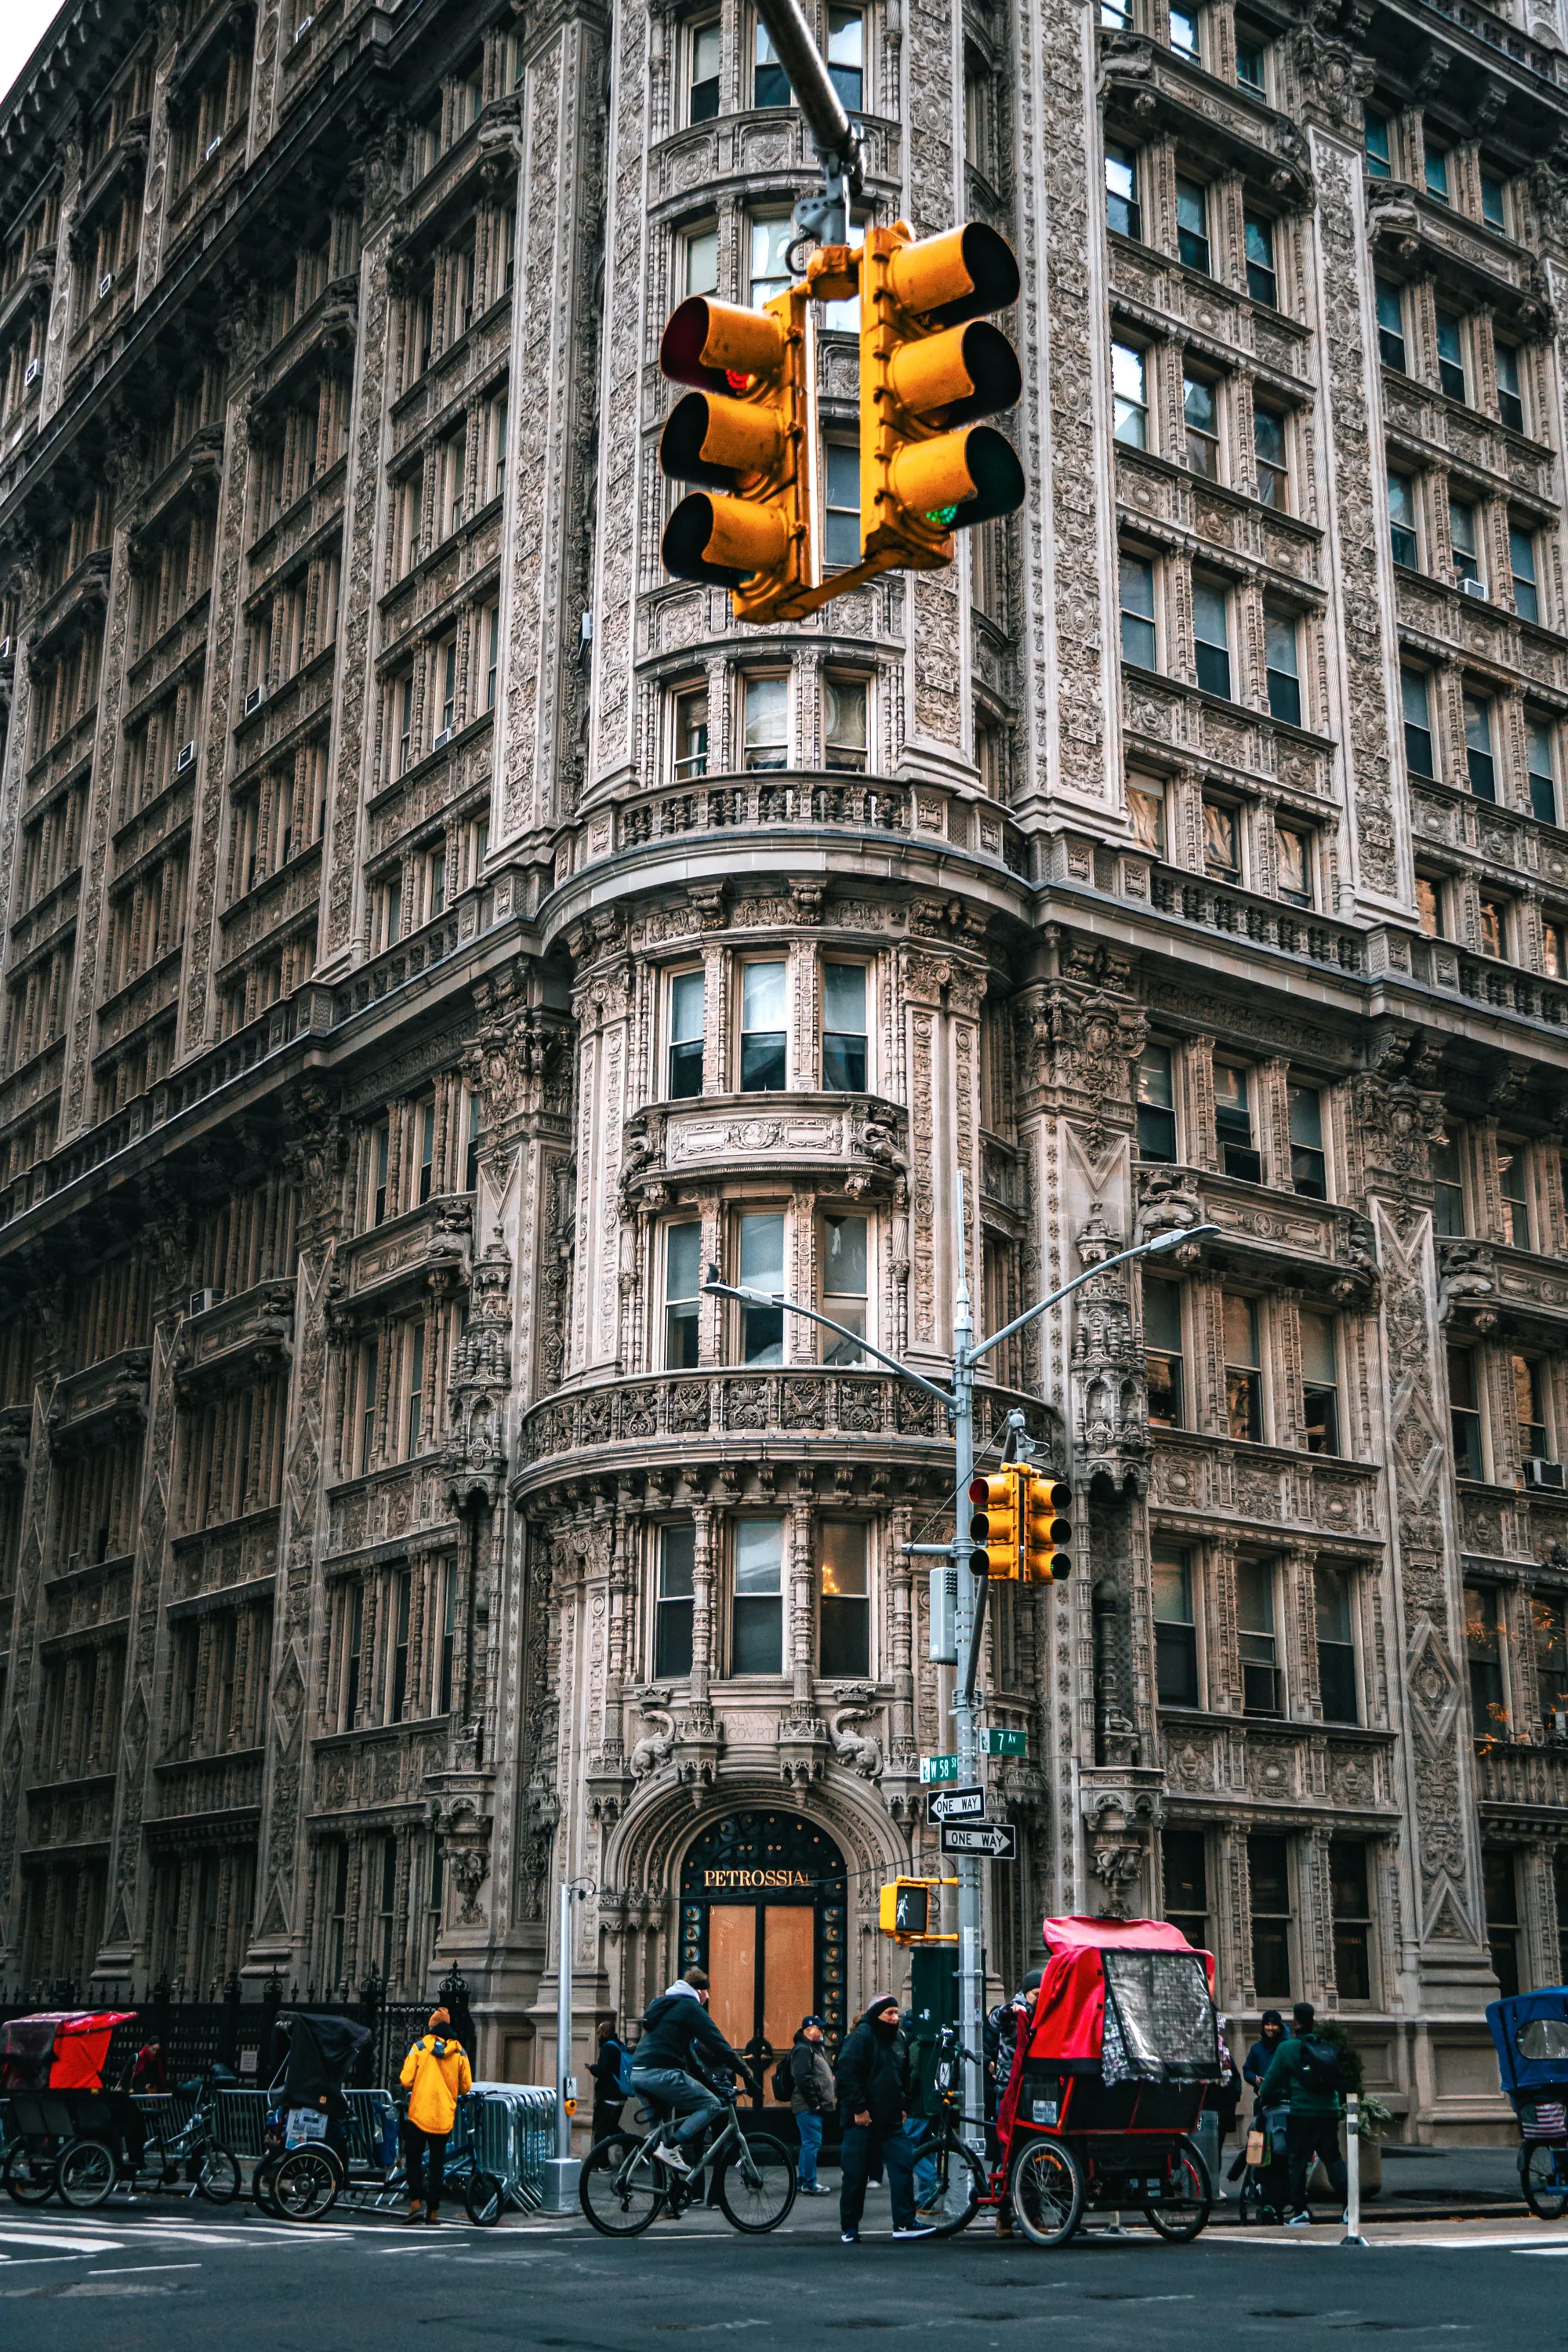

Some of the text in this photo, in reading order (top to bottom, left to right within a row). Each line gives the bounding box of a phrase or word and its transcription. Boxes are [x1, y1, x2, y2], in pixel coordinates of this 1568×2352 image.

[728, 1715, 775, 1726] ALWYN
[998, 1733, 1016, 1750] 7 Av
[931, 1761, 937, 1778] W
[939, 1759, 949, 1778] 58
[937, 1797, 978, 1813] ONE WAY
[951, 1832, 1004, 1847] ONE WAY
